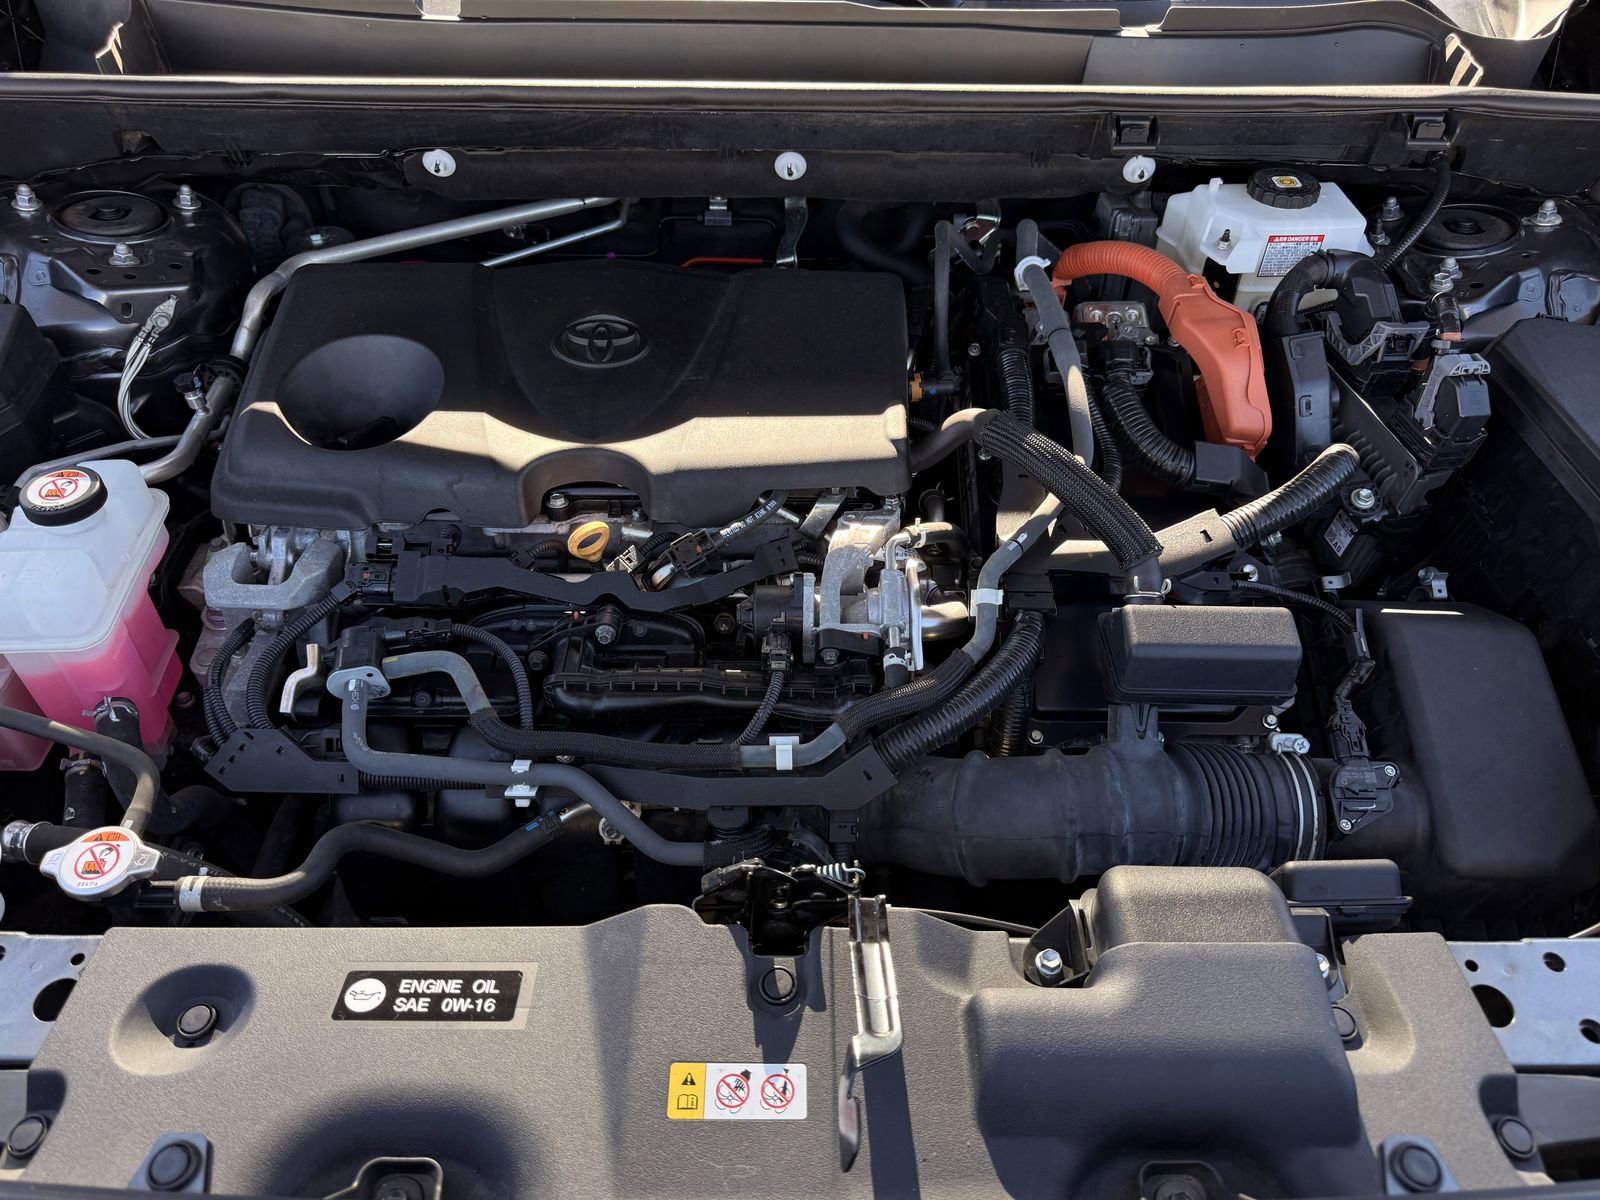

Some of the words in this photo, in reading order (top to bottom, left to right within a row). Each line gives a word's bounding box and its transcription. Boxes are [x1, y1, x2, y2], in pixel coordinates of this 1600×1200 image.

[399, 979, 463, 993] ENGINE
[472, 979, 500, 993] OIL
[393, 998, 431, 1012] SAE
[441, 998, 496, 1012] 0W-16
